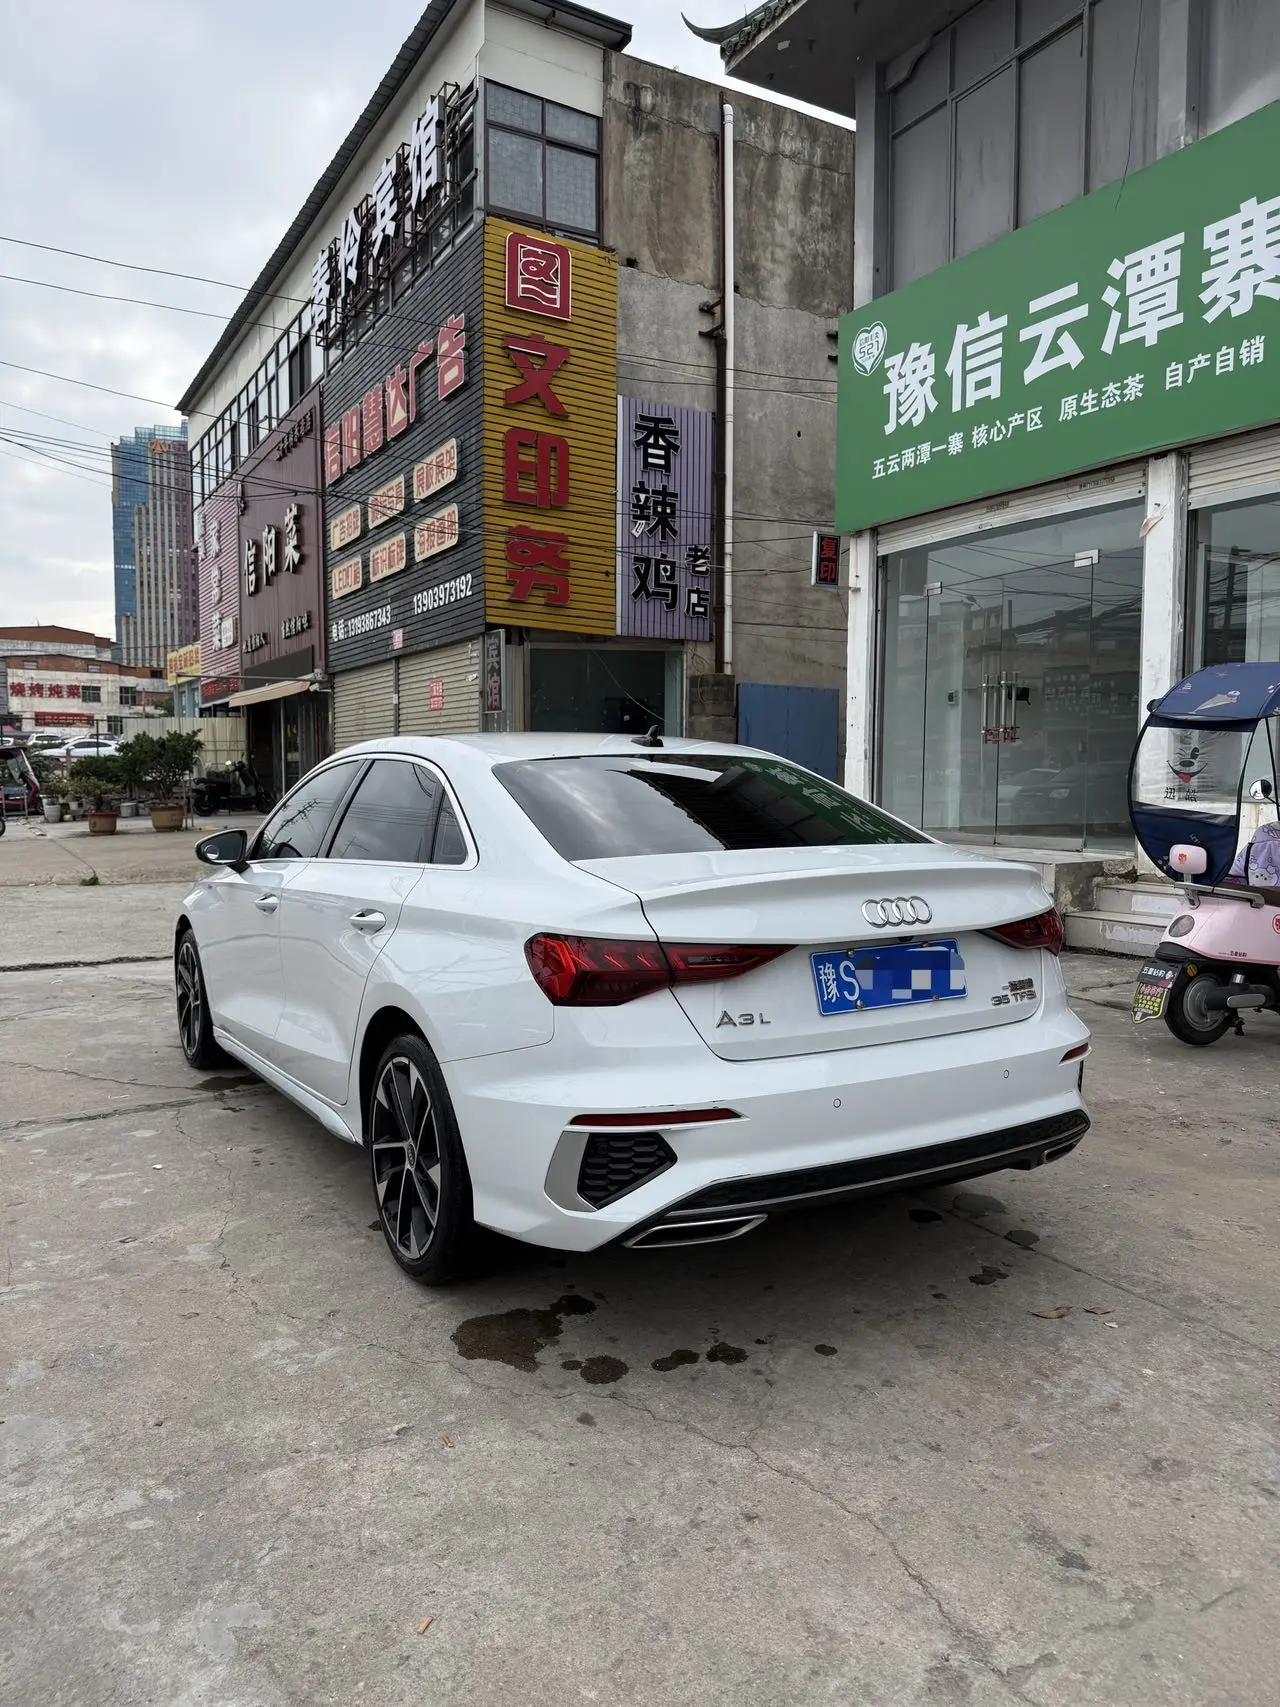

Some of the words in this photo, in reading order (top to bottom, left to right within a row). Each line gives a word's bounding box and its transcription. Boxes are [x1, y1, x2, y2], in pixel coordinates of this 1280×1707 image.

[883, 196, 1280, 436] 豫信云潭寨
[325, 313, 466, 487] 信阳慧达广告
[505, 231, 572, 606] 图文印务
[872, 432, 964, 480] 五云两潭一寨
[971, 406, 1043, 448] 核心产区
[1058, 373, 1145, 422] 原生态茶
[1164, 335, 1266, 391] 自产自销
[244, 503, 300, 596] 信阳菜
[631, 413, 681, 612] 香辣鸡
[820, 538, 838, 581] 复印
[413, 573, 472, 615] 13903973192
[685, 544, 710, 618] 老店
[991, 994, 1010, 1006] 35
